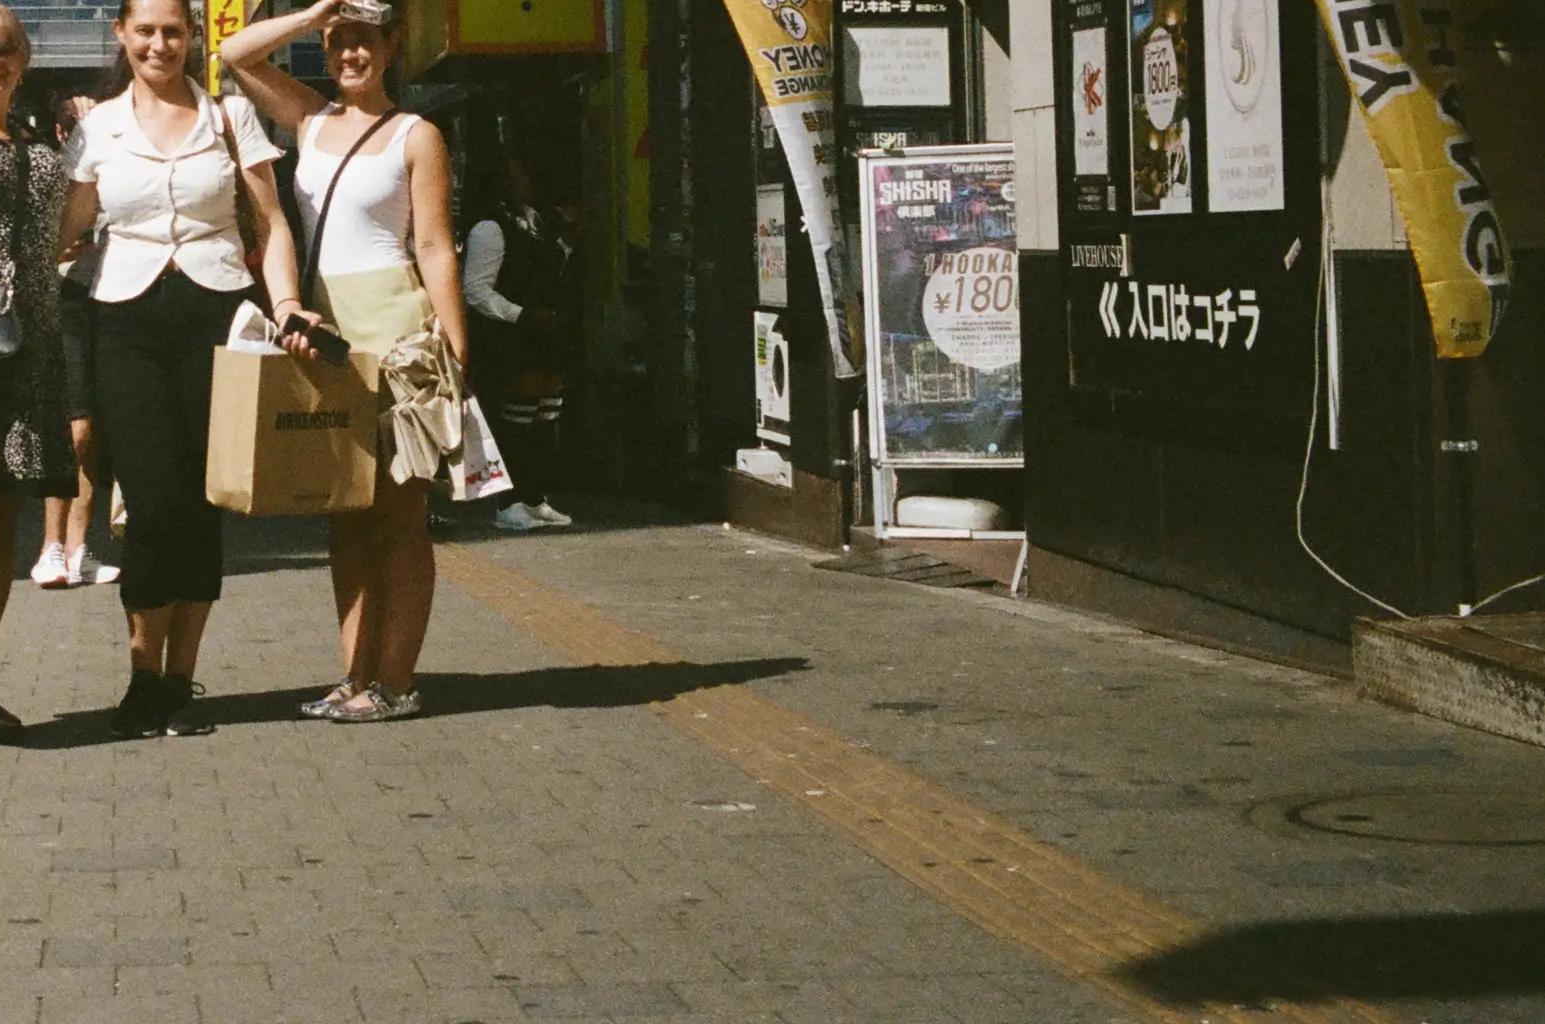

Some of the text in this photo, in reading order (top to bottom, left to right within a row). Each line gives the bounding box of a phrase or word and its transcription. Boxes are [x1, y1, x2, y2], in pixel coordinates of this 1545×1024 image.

[879, 179, 952, 205] SHISHA
[942, 252, 1019, 275] HOOKA
[1071, 244, 1124, 268] LIVEHOUSE
[274, 409, 352, 432] BIRKENSTOCK
